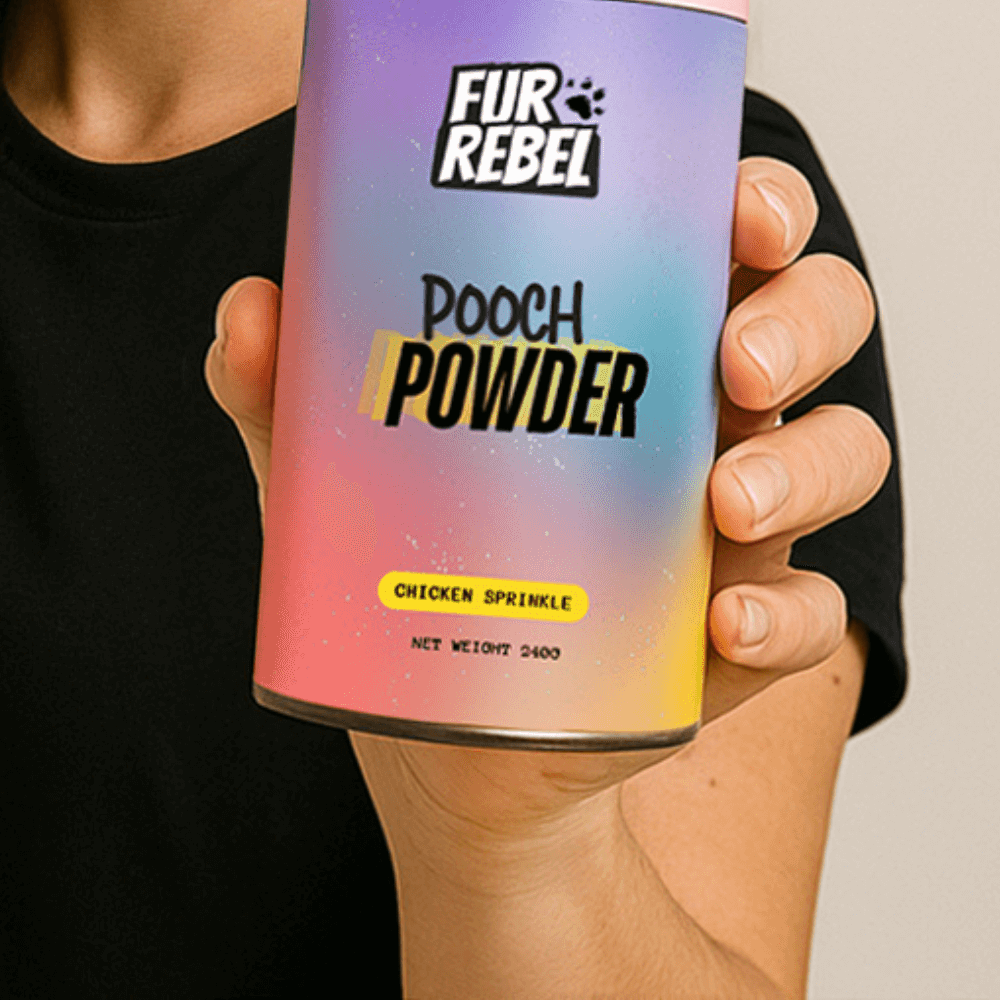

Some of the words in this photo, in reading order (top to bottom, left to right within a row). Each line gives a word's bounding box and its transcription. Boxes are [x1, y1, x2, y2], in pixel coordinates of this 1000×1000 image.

[450, 68, 557, 124] FUR
[437, 124, 594, 188] REBEL
[421, 273, 583, 345] POOCH
[384, 341, 649, 439] POWDER
[394, 583, 473, 602] CHICKEN
[483, 589, 572, 611] SPRINKLE
[411, 636, 442, 651] NET
